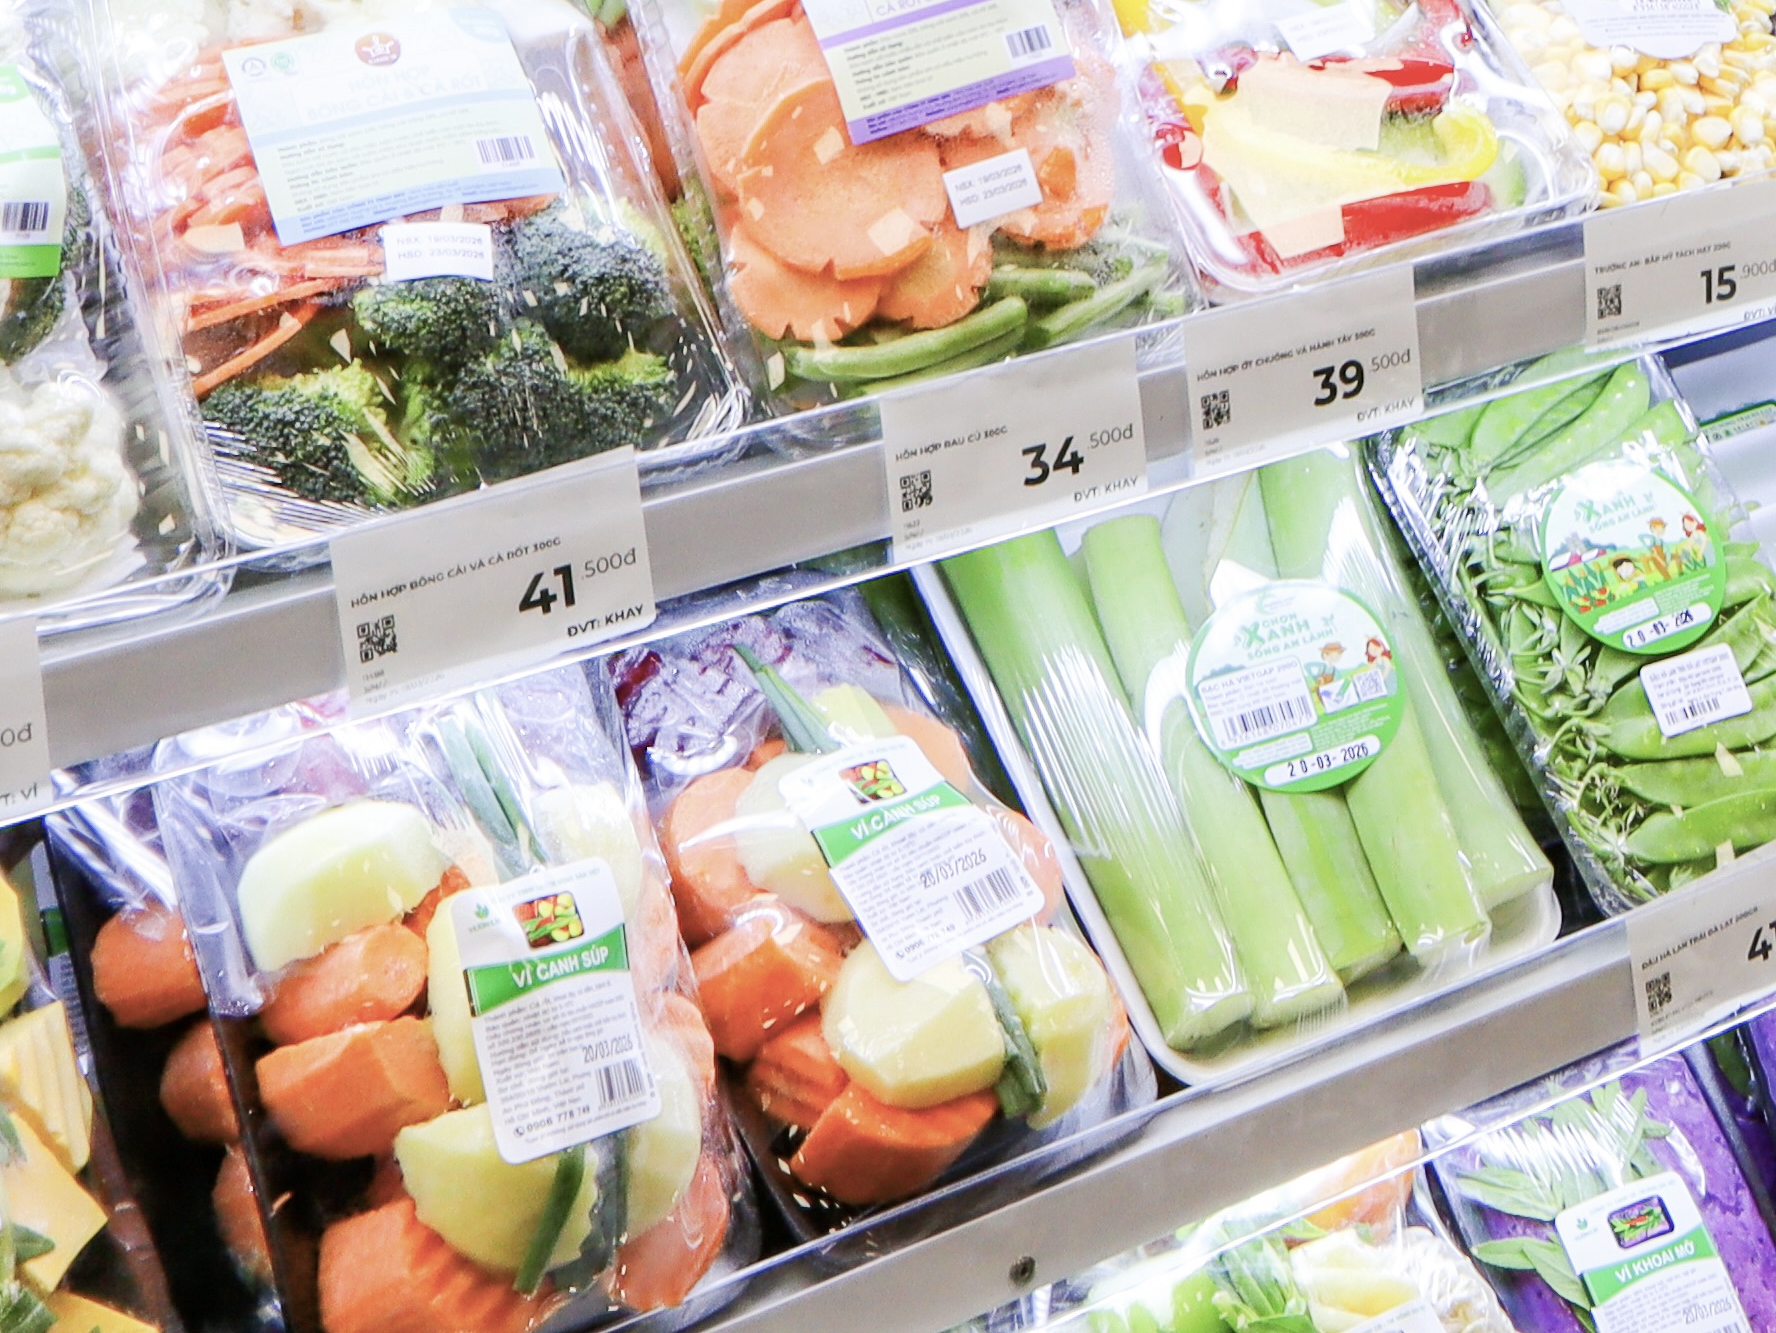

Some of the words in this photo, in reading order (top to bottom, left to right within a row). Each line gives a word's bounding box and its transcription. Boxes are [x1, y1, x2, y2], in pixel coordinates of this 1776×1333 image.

[603, 604, 646, 626] KHAY
[537, 954, 580, 984] CANH
[581, 944, 610, 970] SÚP
[583, 1033, 634, 1065] 20/03/2026
[1633, 1249, 1674, 1275] KHOAI
